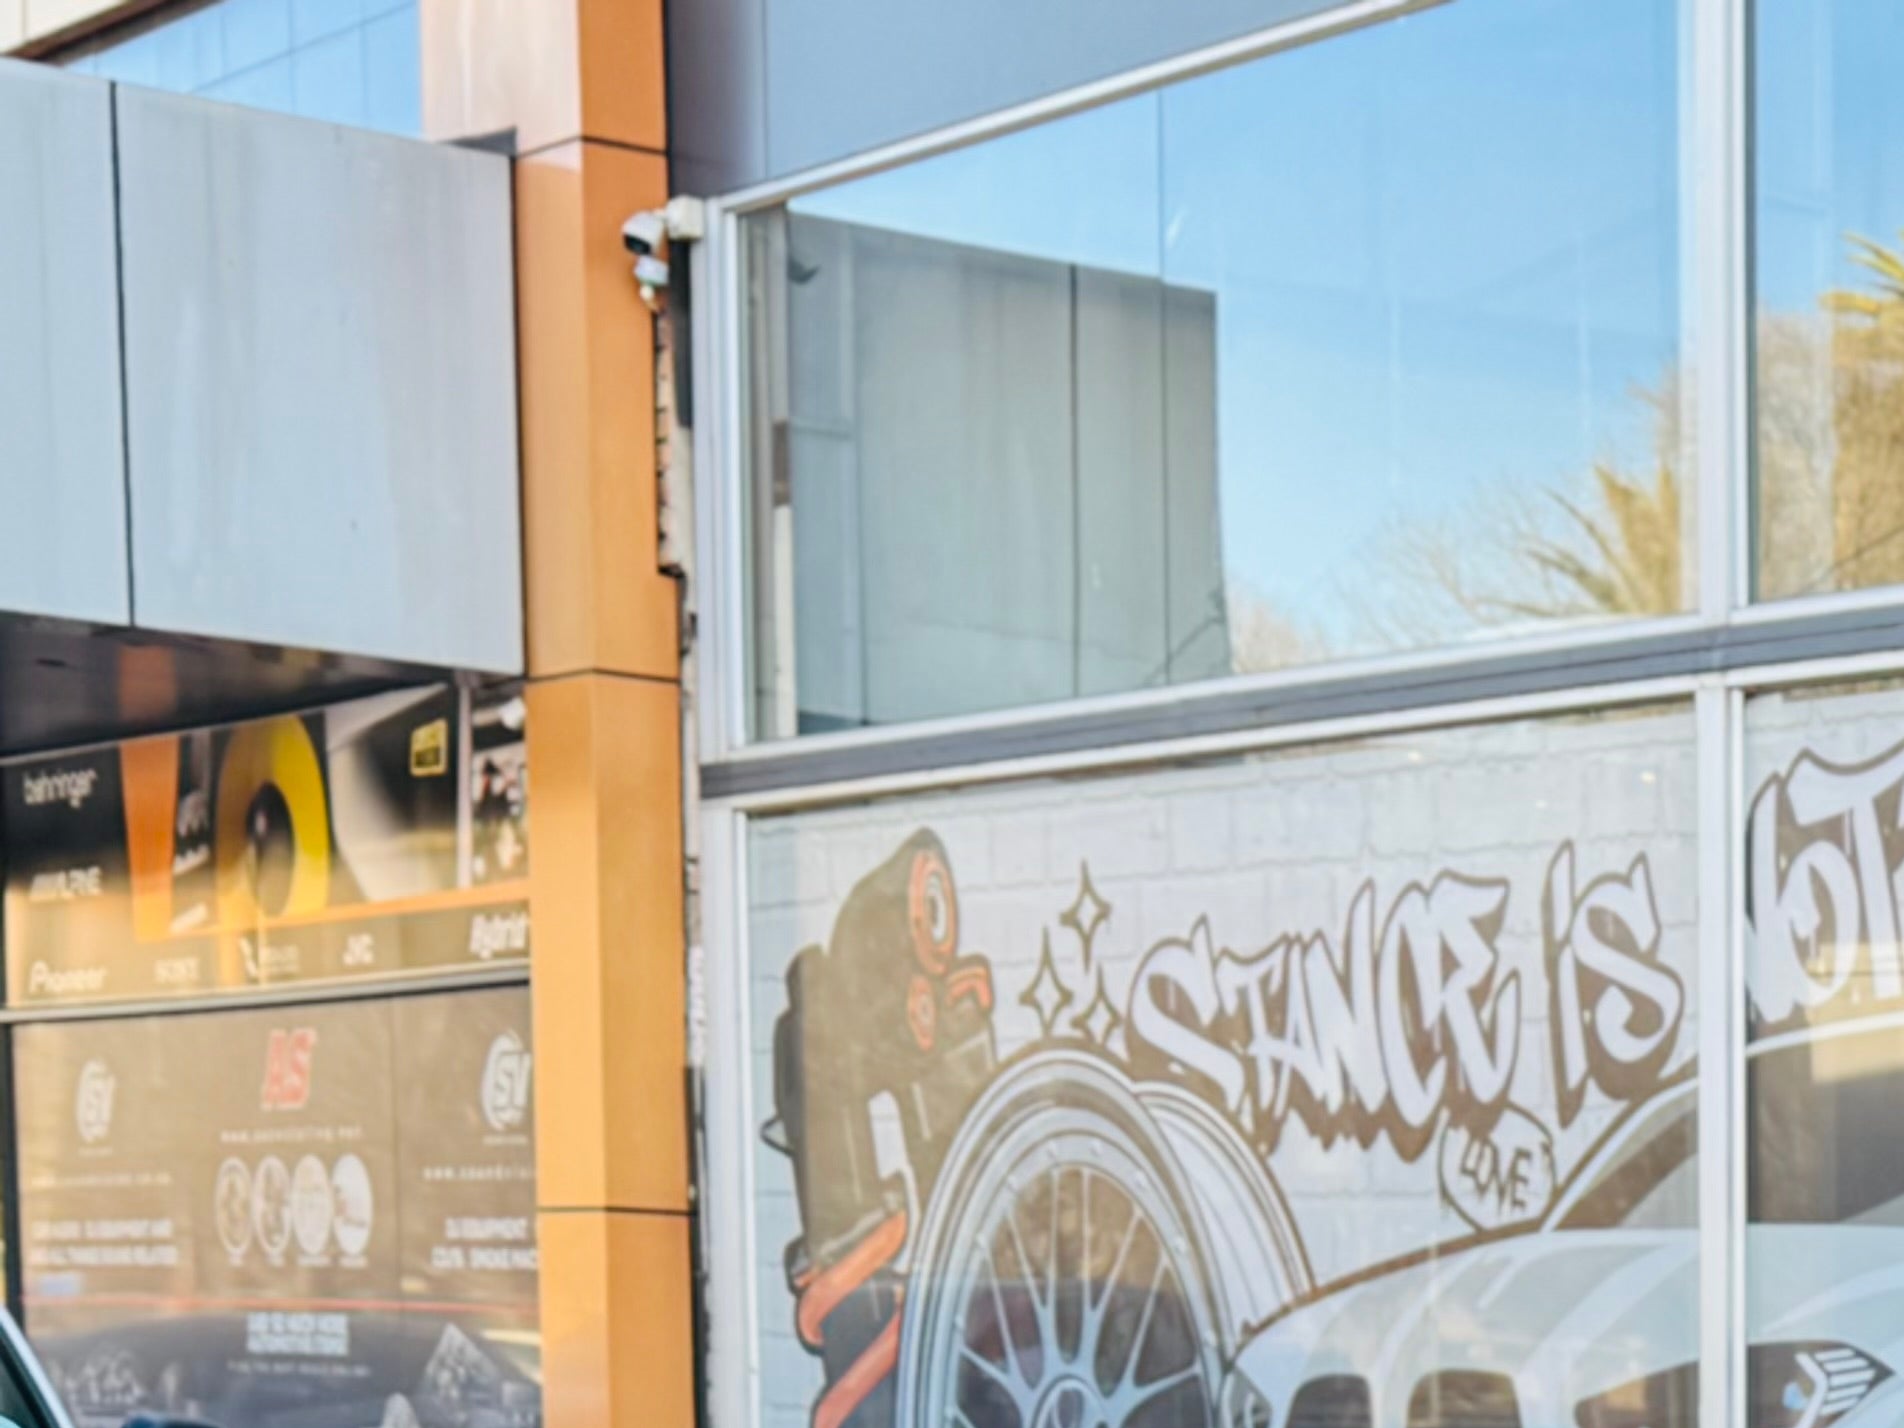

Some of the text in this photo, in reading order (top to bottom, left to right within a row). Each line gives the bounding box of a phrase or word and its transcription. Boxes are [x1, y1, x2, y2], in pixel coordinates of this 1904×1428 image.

[1106, 838, 1685, 1158] STANCE IS
[1459, 1132, 1533, 1213] LOVE
